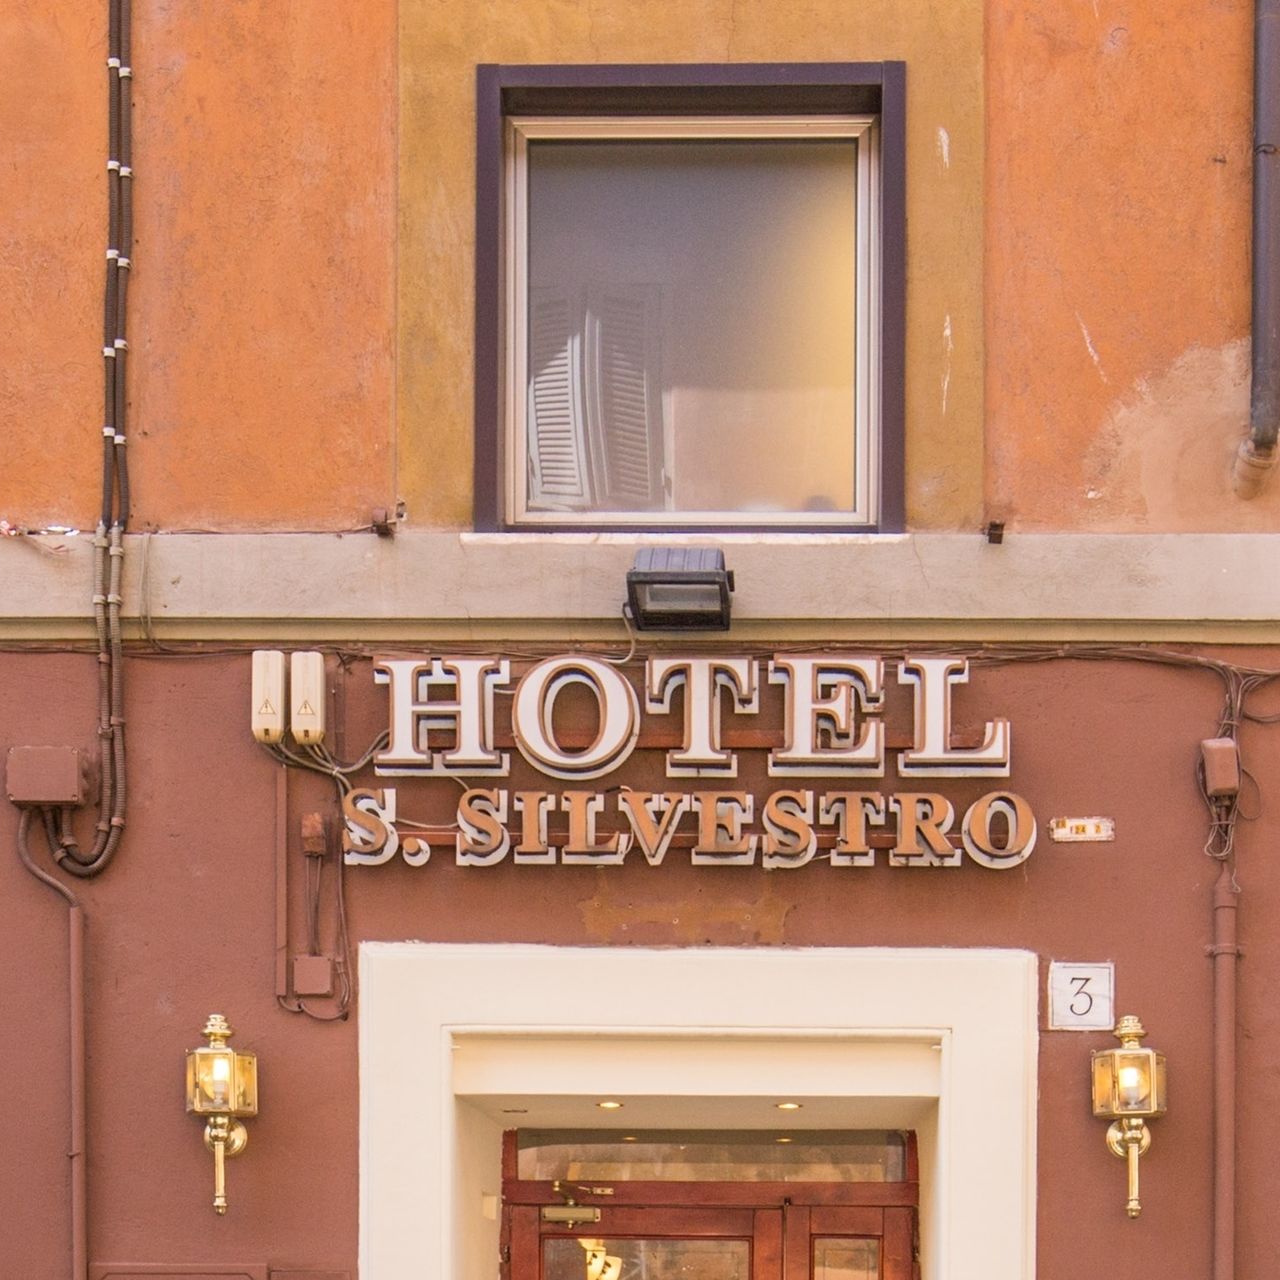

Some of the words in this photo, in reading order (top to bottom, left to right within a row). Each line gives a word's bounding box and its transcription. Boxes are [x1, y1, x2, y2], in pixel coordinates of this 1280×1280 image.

[375, 656, 1011, 780] HOTEL
[344, 788, 430, 865] S.
[456, 786, 1036, 869] SILVESTRO
[1070, 977, 1093, 1016] 3
